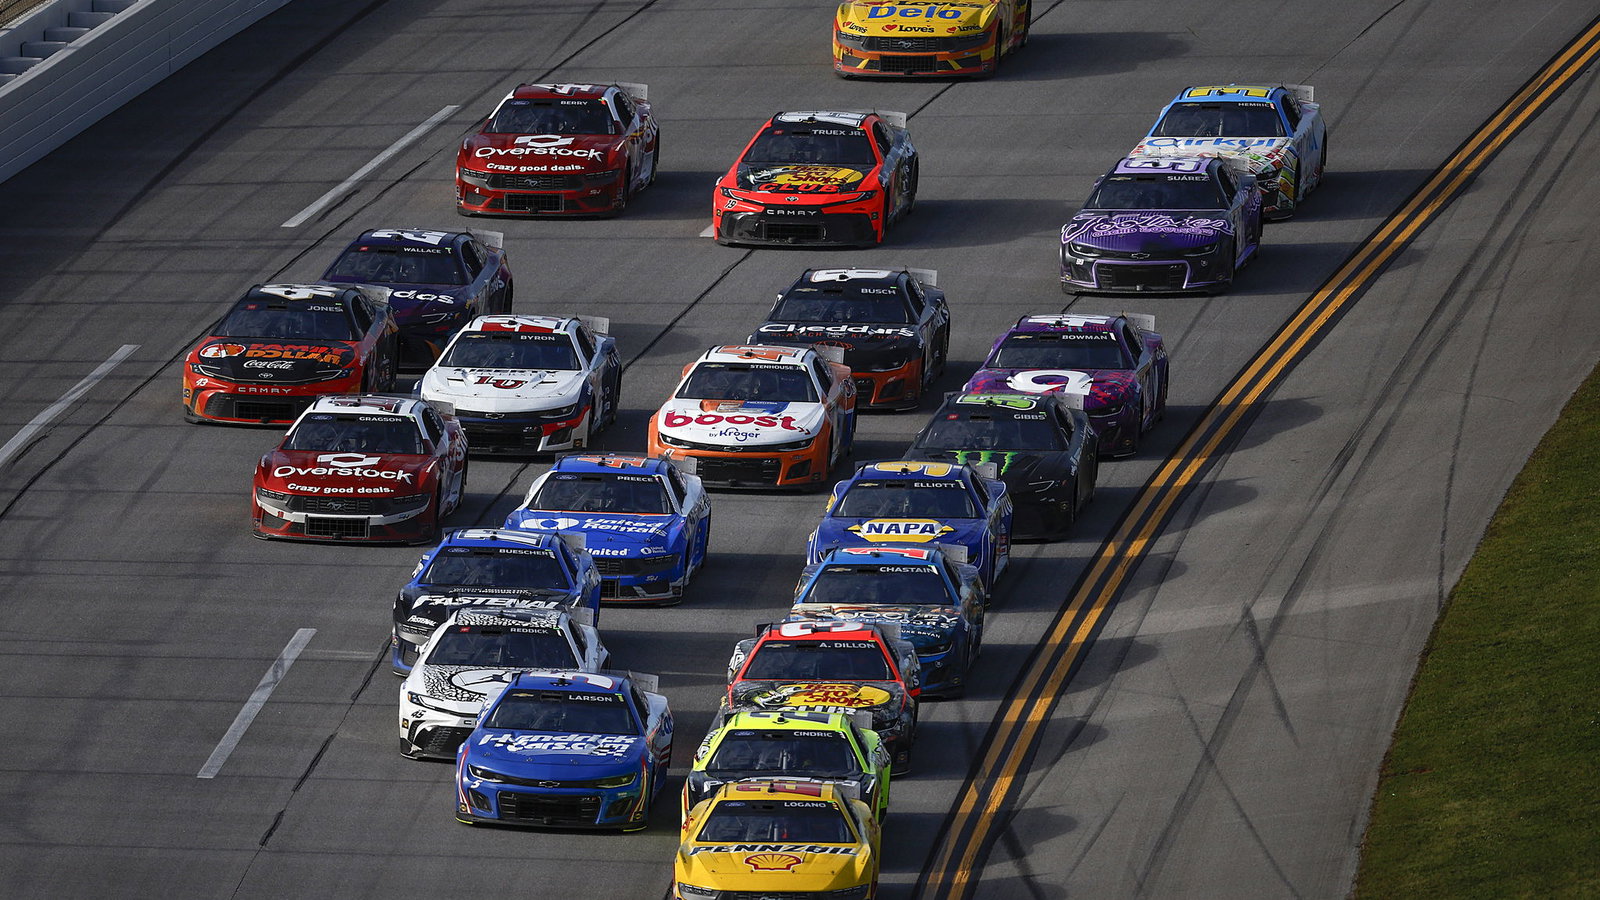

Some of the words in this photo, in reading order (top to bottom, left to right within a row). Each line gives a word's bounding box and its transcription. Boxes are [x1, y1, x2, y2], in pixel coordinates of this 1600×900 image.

[867, 6, 962, 19] Delo
[1145, 137, 1277, 148] Cirkul
[474, 146, 604, 163] Overstock
[486, 162, 517, 172] Crazy
[519, 164, 548, 172] good
[550, 164, 585, 172] deals.
[787, 175, 848, 184] Shops
[474, 187, 480, 195] 4
[758, 182, 840, 193] CLUB
[724, 199, 738, 209] 19
[307, 305, 344, 313] JONES
[248, 343, 352, 355] FAMILY
[244, 350, 343, 366] DOLLAR
[195, 378, 208, 387] 43
[238, 386, 292, 394] CAMRY
[664, 410, 798, 432] boost
[719, 426, 761, 442] Kroger
[273, 465, 415, 485] Overstock
[287, 482, 321, 494] Crazy
[323, 485, 355, 494] good
[357, 485, 395, 494] deals.
[585, 518, 664, 528] United
[866, 523, 936, 534] NAPA
[582, 522, 667, 537] Rentals
[879, 566, 933, 574] CHASTAIN
[411, 595, 559, 610] FASTENAL
[568, 694, 613, 702] LARSON
[804, 695, 875, 706] Shops
[411, 709, 427, 719] 45
[478, 734, 637, 747] Hendrick
[470, 780, 483, 788] 5
[690, 844, 859, 856] PENNZOIL
